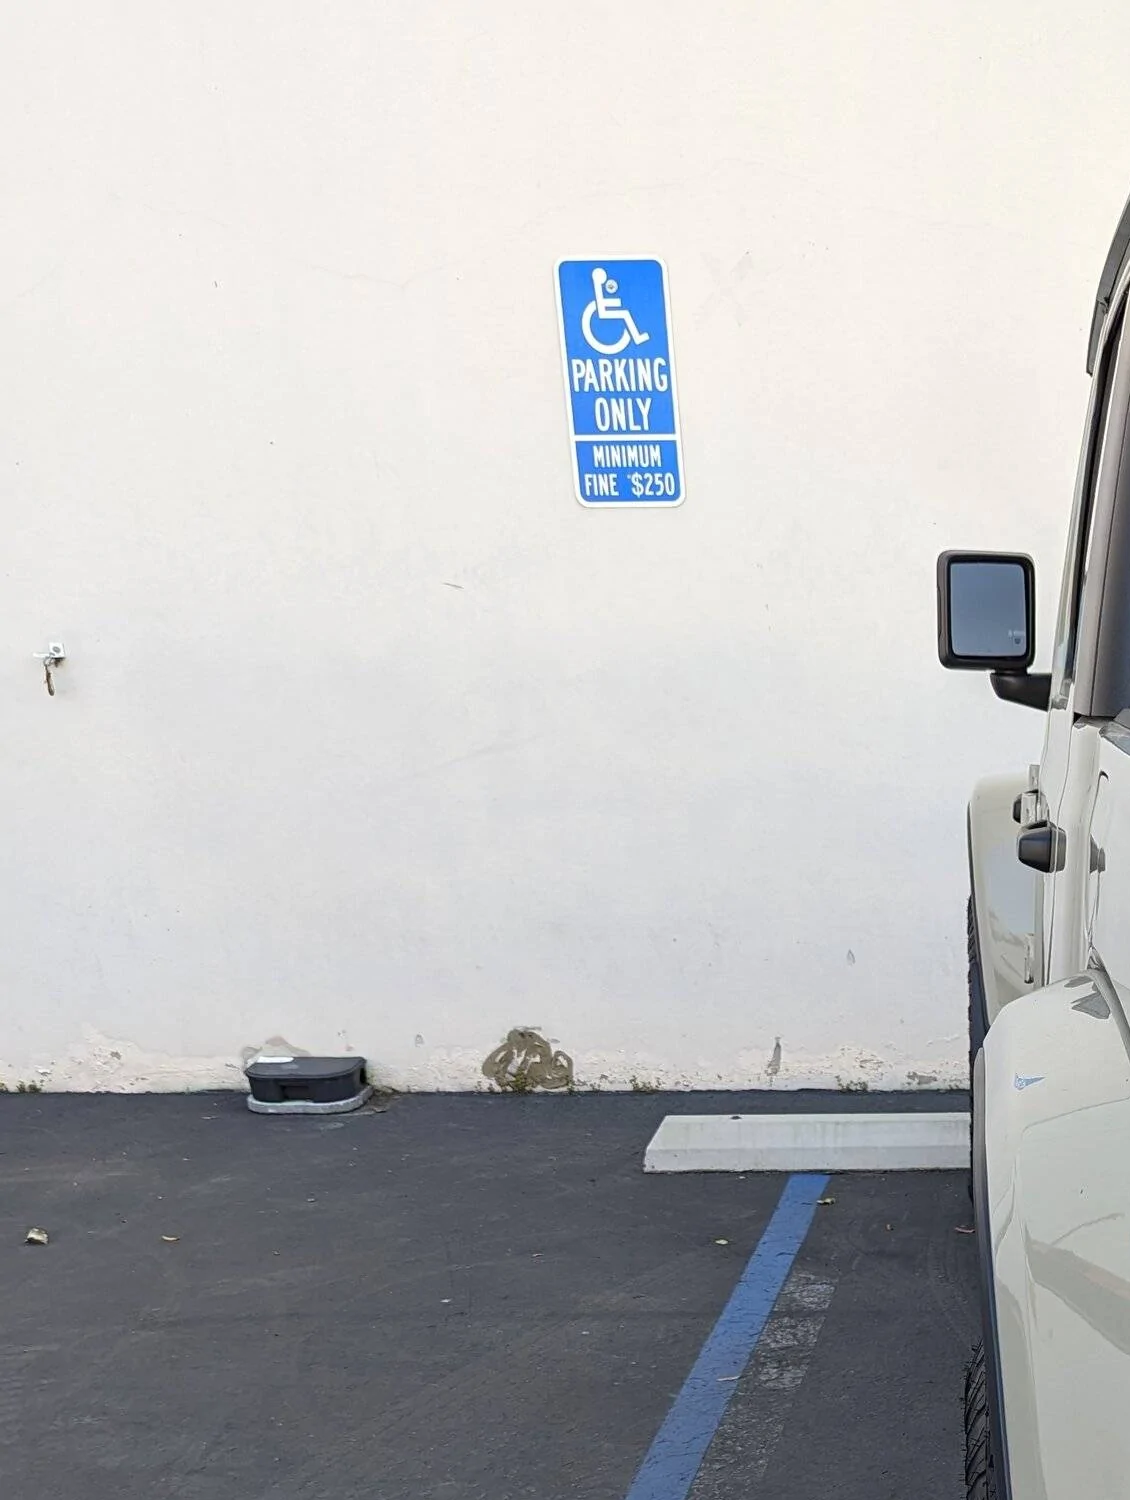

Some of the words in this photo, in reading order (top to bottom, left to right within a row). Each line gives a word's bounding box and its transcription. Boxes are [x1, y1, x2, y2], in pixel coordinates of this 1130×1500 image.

[572, 357, 668, 392] PARKING
[594, 397, 651, 431] ONLY
[593, 444, 661, 467] MINIMUM
[584, 472, 618, 496] FINE
[631, 472, 675, 498] $250
